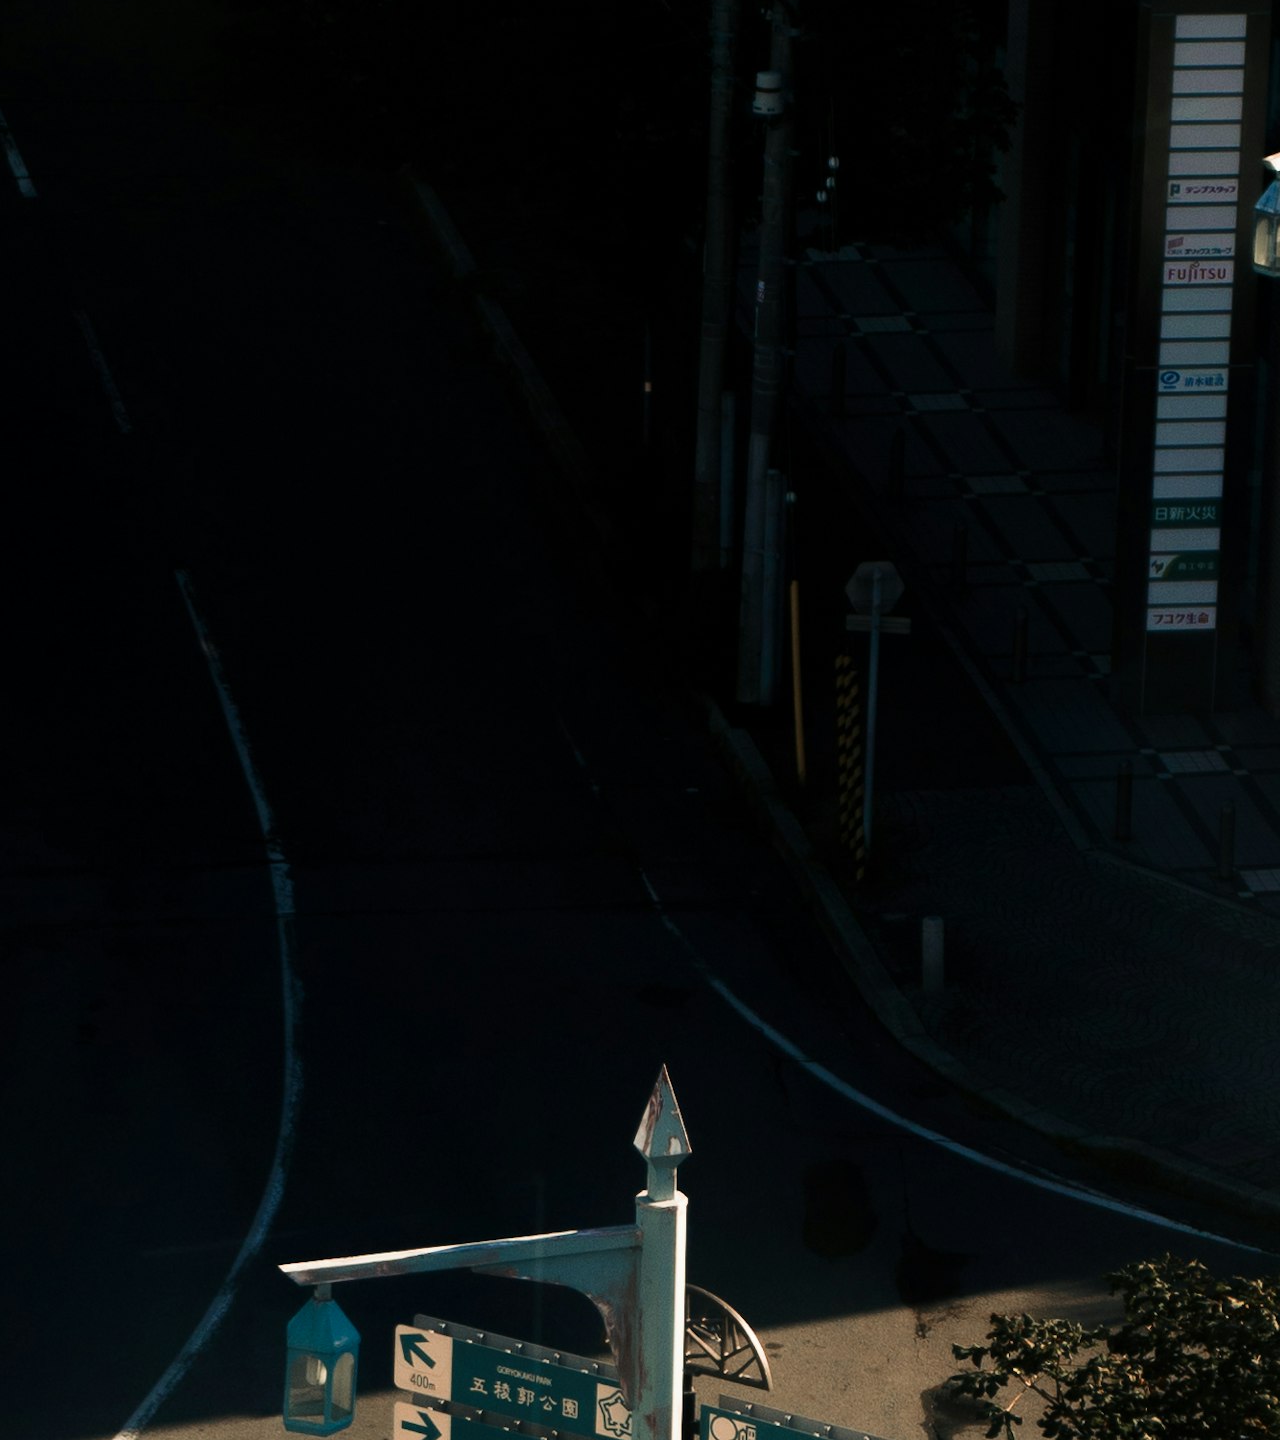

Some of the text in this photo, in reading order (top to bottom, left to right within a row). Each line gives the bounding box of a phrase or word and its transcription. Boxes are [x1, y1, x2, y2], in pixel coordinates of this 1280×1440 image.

[1168, 261, 1226, 282] FUJITSU
[1184, 373, 1224, 387] 清水建設
[1155, 505, 1216, 521] 日新火災
[1153, 612, 1209, 626] フコク生命
[410, 1372, 436, 1391] 400m
[496, 1365, 552, 1387] GORYOKAKU PARK
[469, 1376, 578, 1420] 五稜郭公園
